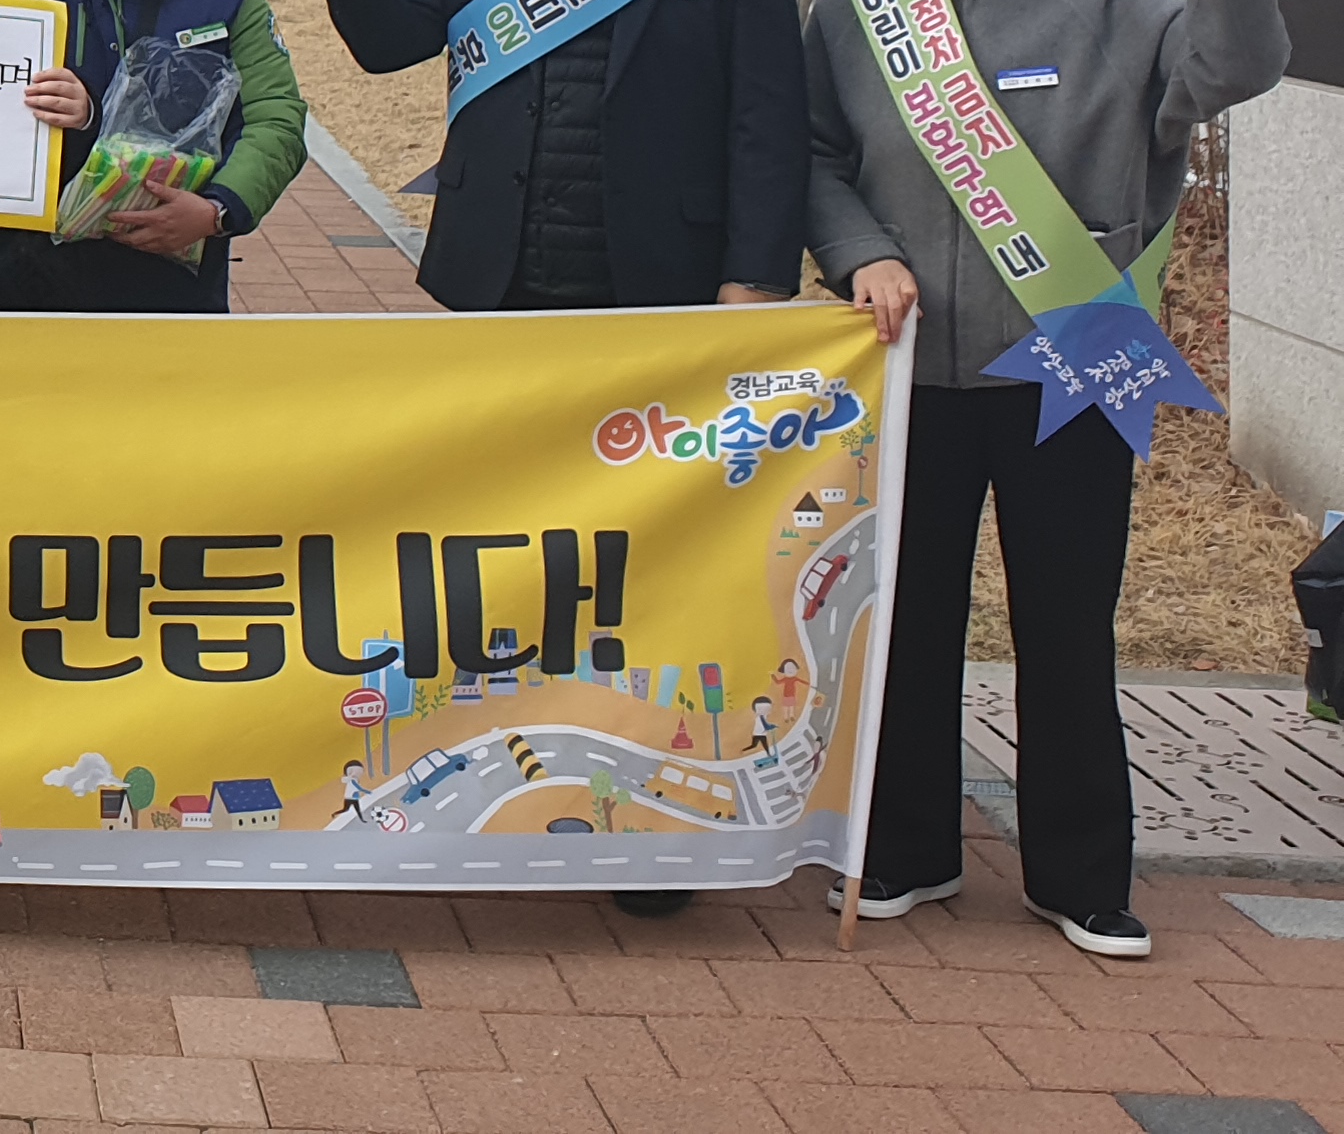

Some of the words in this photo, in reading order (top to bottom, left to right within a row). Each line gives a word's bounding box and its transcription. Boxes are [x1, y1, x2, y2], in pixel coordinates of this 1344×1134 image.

[944, 72, 1015, 158] 금지
[905, 84, 1015, 228] 보호구역
[997, 234, 1049, 280] 내
[730, 371, 820, 400] 경남교육
[597, 391, 862, 485] 아이좋아
[9, 527, 631, 683] 만듭니다!
[348, 704, 382, 716] STOP
